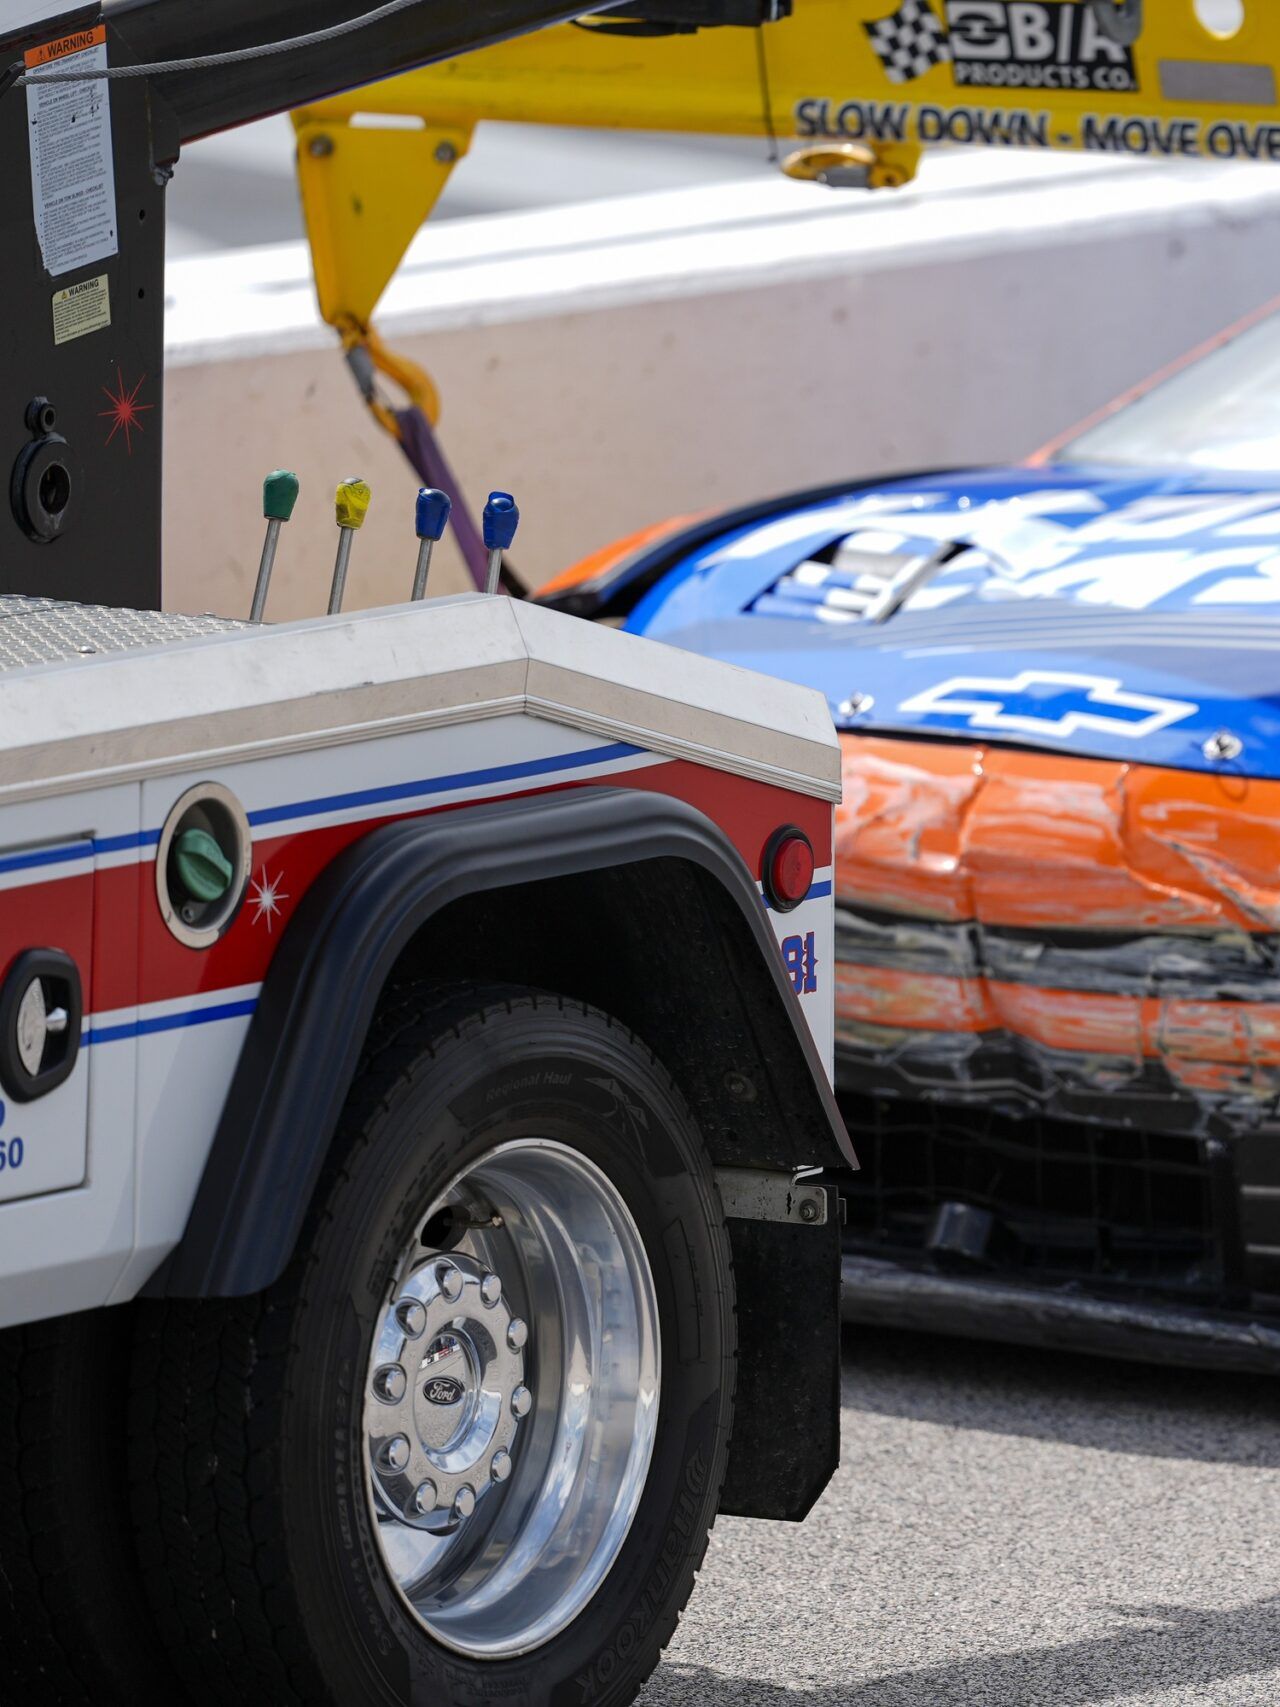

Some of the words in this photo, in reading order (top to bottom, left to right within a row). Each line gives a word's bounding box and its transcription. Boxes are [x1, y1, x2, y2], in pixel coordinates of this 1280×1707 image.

[47, 31, 94, 58] WARNING
[955, 62, 1089, 89] PRODUCTS
[1092, 66, 1137, 91] CO.
[794, 97, 908, 141] SLOW
[917, 104, 1050, 147] DOWN
[1081, 114, 1198, 157] MOVE
[68, 278, 99, 297] WARNING
[485, 1072, 540, 1102] Regional
[543, 1071, 573, 1088] Haul
[430, 1381, 456, 1401] Ford
